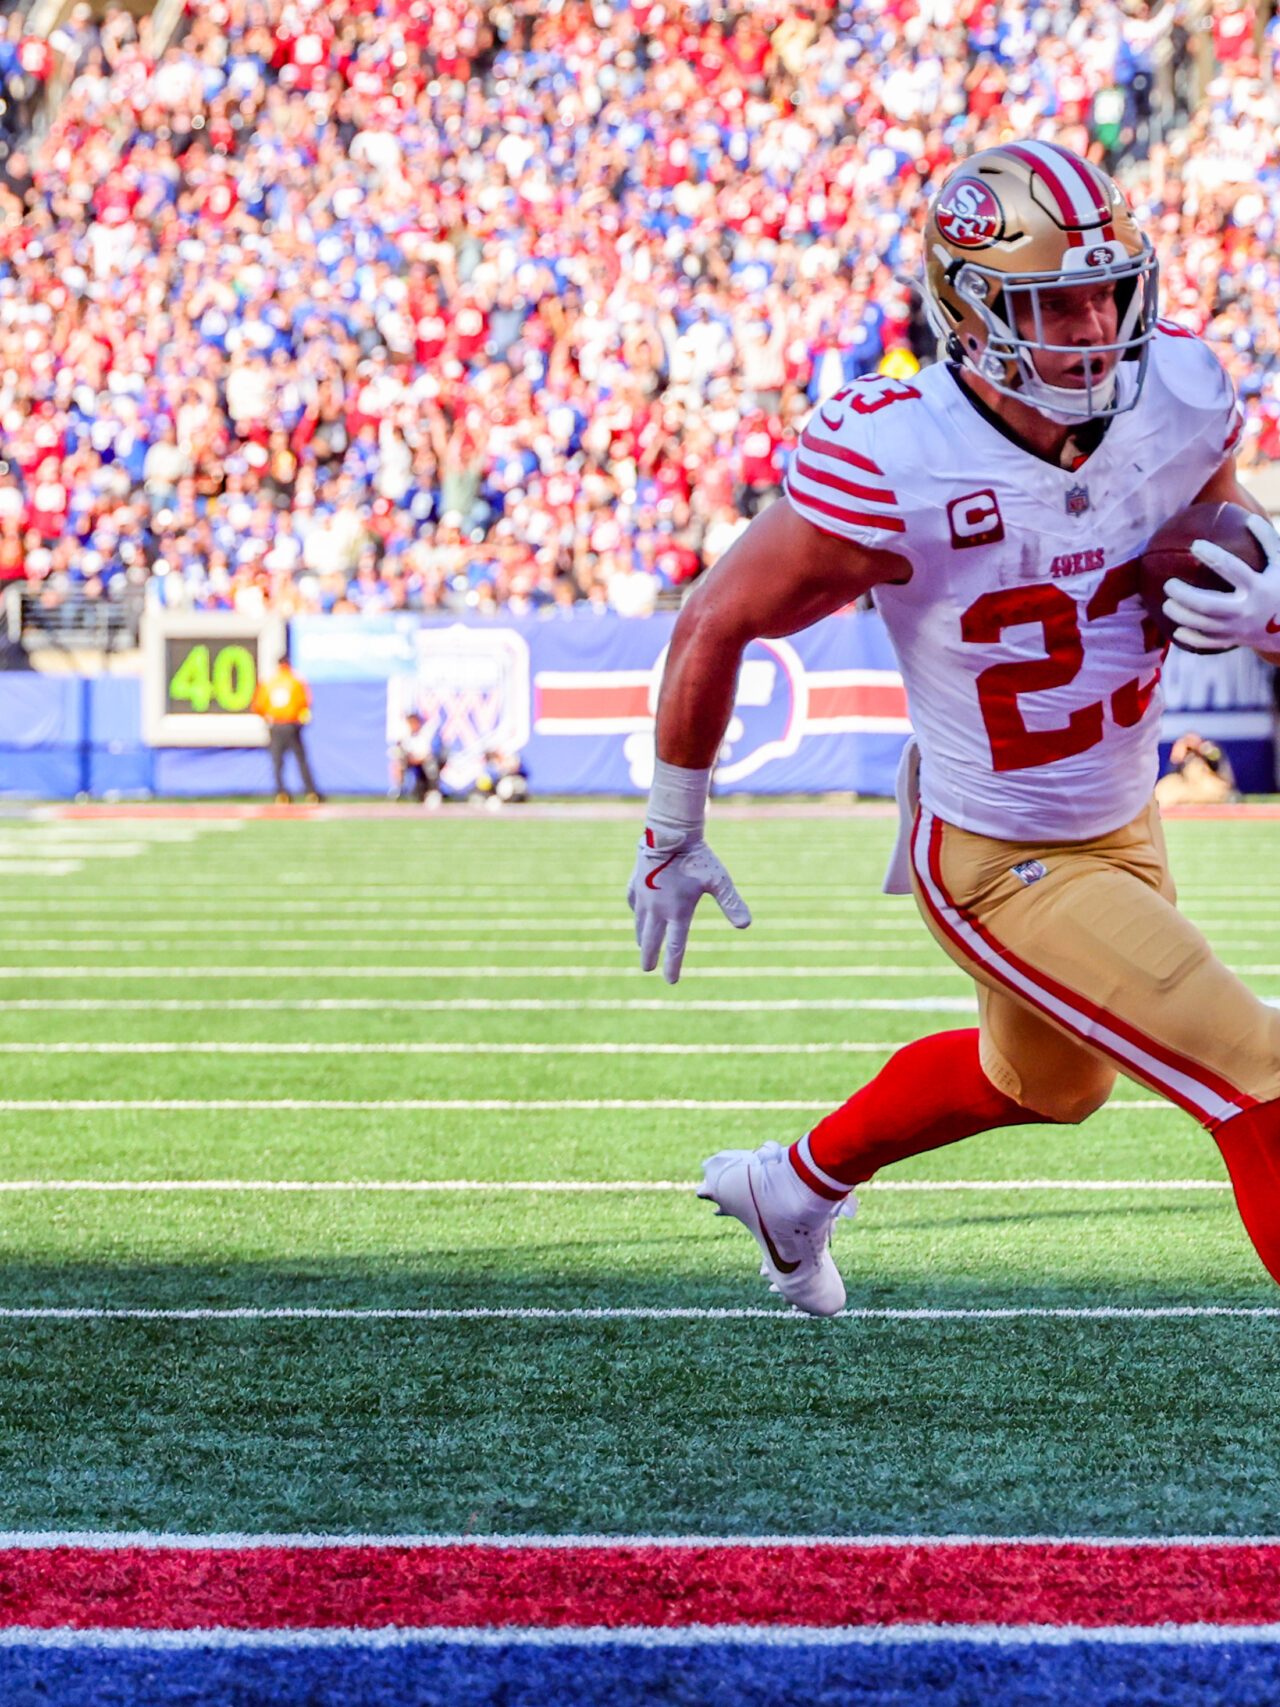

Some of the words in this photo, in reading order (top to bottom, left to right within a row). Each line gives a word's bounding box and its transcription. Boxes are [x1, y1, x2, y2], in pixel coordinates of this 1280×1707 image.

[951, 494, 1000, 538] C
[1050, 547, 1105, 578] 49ERS
[169, 644, 256, 713] 40
[960, 554, 1170, 772] 23
